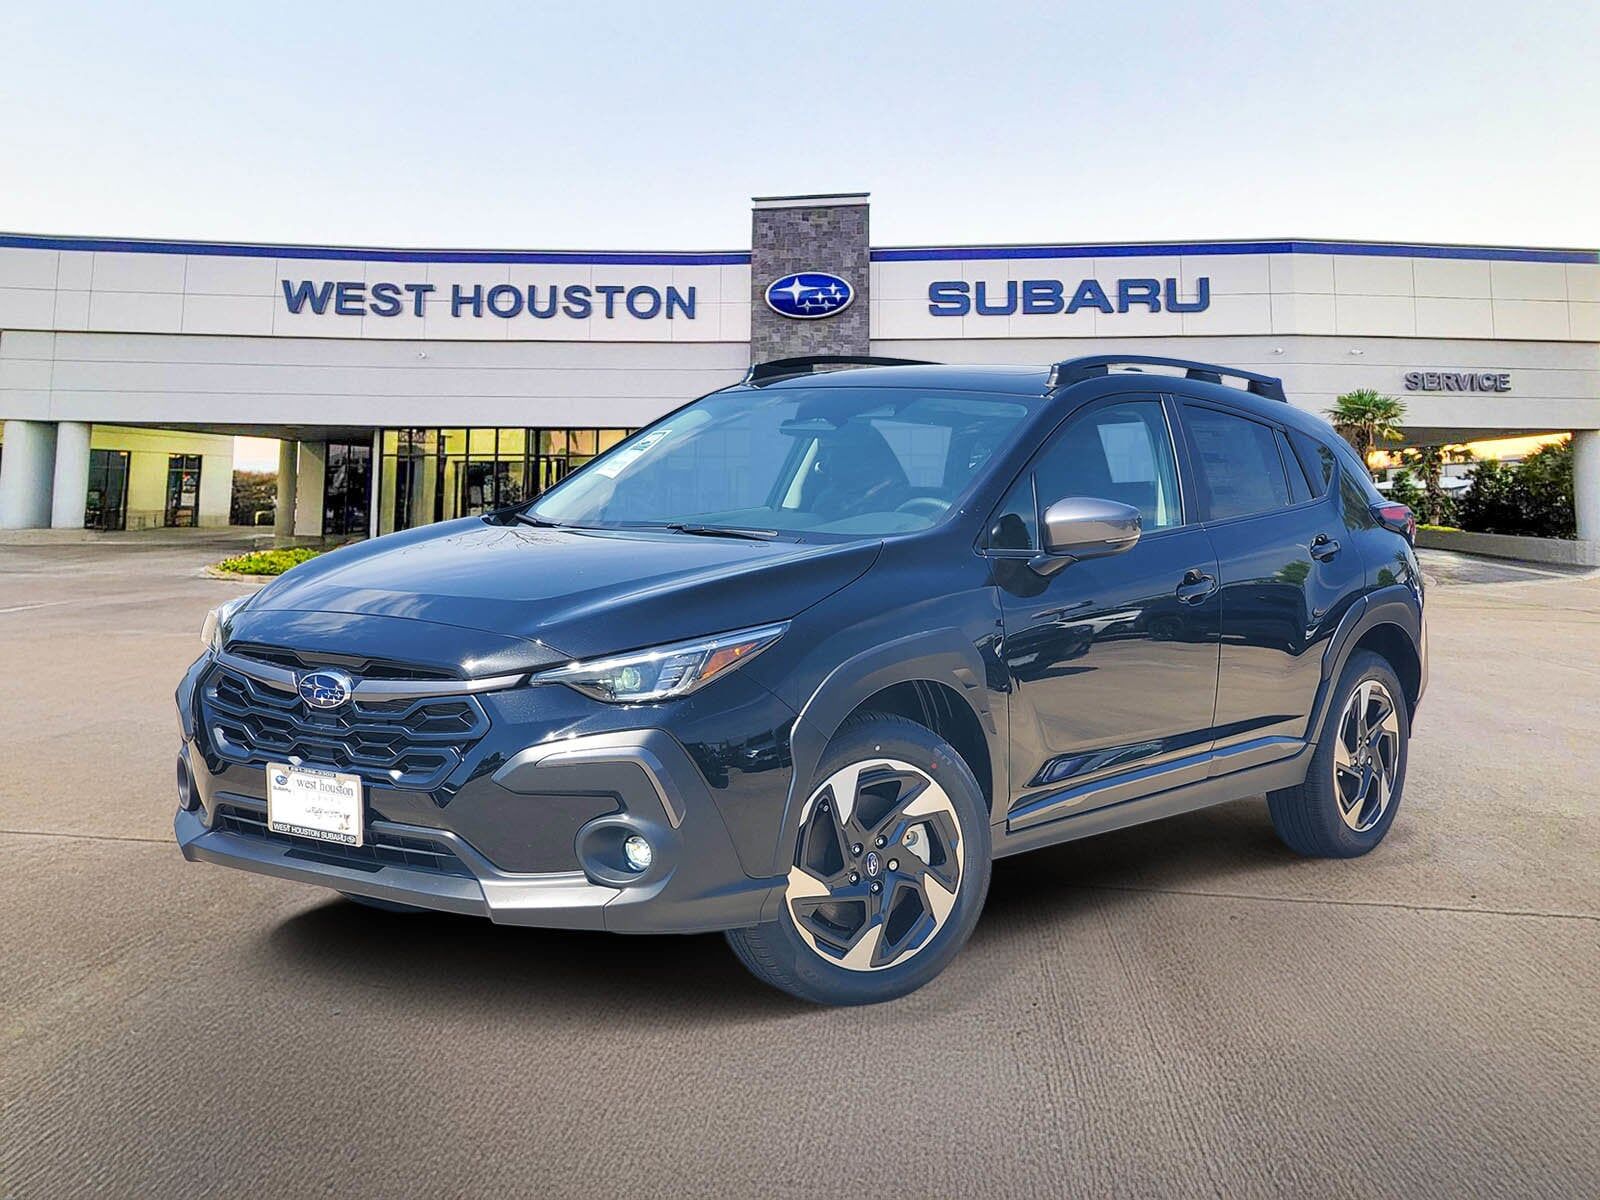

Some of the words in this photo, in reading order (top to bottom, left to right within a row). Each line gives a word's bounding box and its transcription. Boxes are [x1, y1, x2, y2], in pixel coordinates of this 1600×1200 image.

[281, 279, 436, 318] WEST
[451, 284, 697, 320] HOUSTON
[928, 277, 1210, 316] SUBARU
[1405, 371, 1512, 392] SERVICE
[273, 823, 291, 832] WEST
[291, 826, 320, 838] HOUSTON
[320, 831, 347, 842] SUBARU
